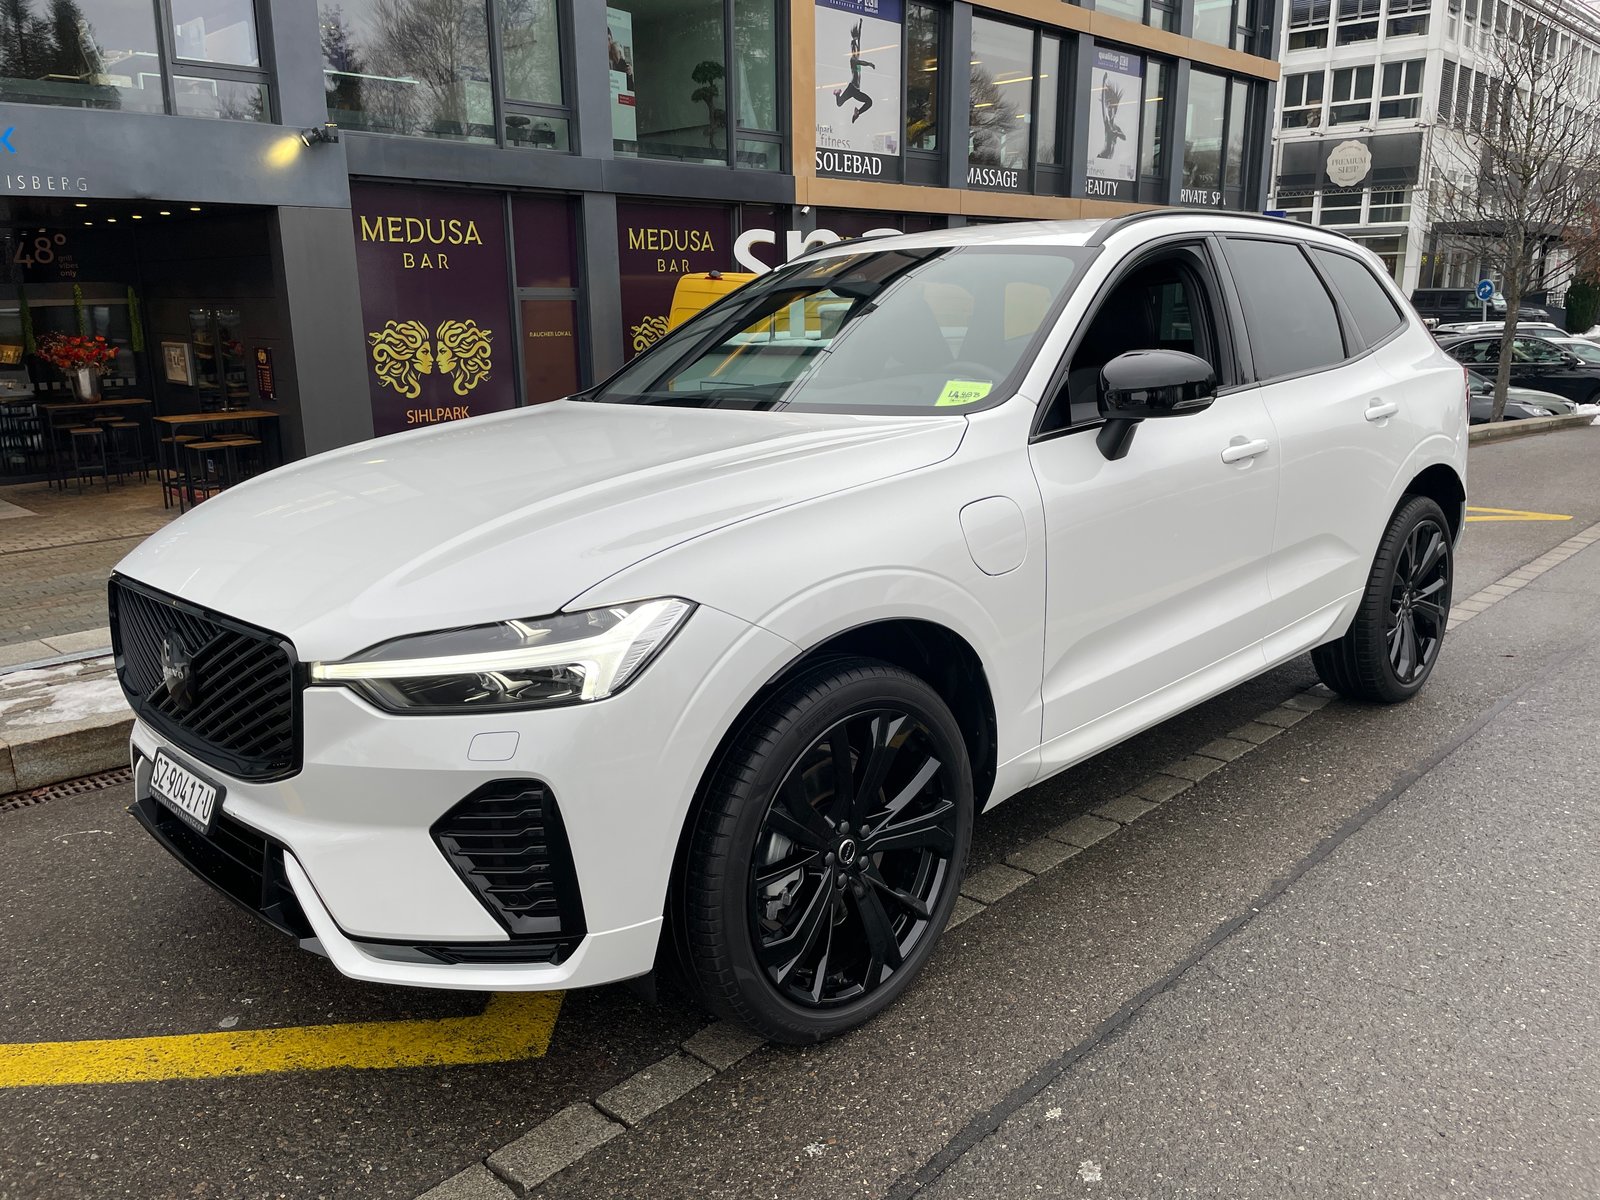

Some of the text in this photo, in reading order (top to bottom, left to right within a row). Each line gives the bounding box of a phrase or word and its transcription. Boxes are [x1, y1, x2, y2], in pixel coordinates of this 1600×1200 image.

[820, 133, 851, 149] fitness
[815, 150, 882, 176] SOLEBAD
[1331, 156, 1367, 166] PREMIUM
[6, 174, 89, 192] ISBERG
[966, 167, 1018, 188] MASSAGE
[360, 215, 483, 246] MEDUSA
[627, 227, 715, 252] MEDUSA
[403, 252, 450, 271] BAR
[657, 258, 691, 273] BAR
[60, 269, 77, 278] only
[406, 405, 470, 424] SIHLPARK
